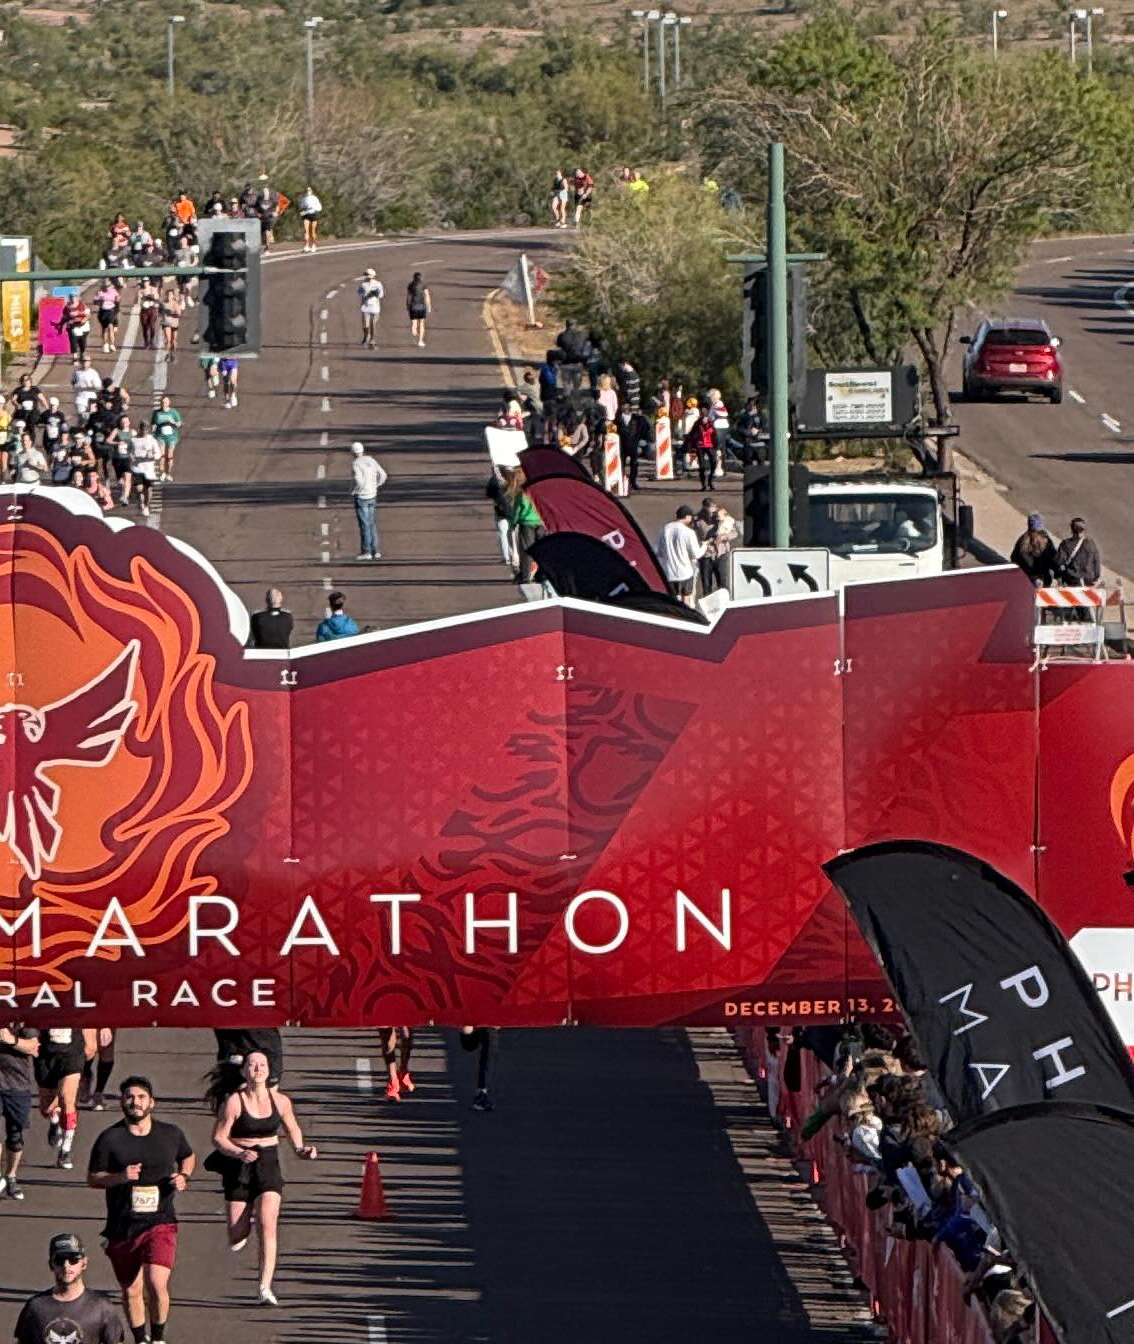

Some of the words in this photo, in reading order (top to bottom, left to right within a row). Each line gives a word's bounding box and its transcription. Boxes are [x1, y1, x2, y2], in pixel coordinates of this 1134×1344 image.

[132, 977, 277, 1008] RACE
[724, 1000, 841, 1017] DECEMBER
[848, 998, 876, 1016] 13,
